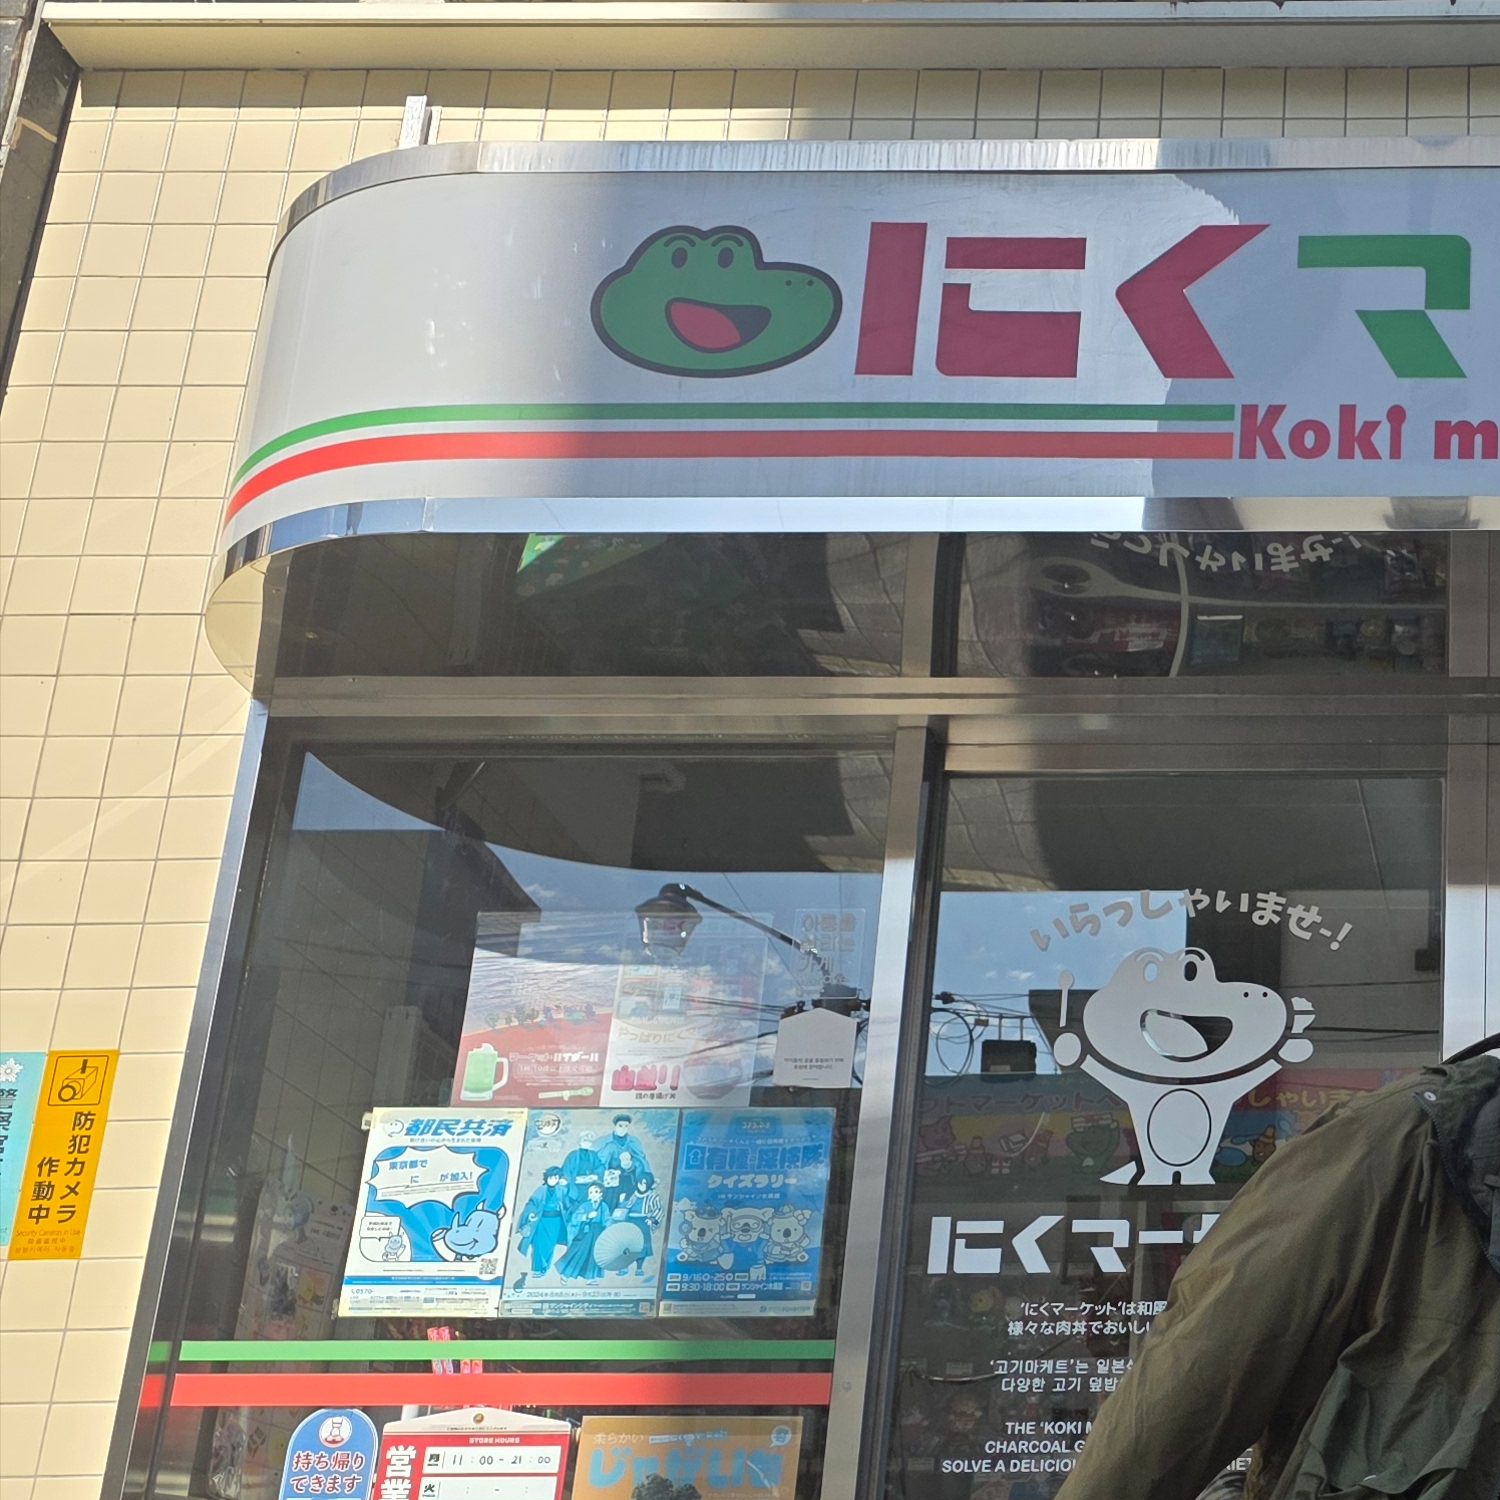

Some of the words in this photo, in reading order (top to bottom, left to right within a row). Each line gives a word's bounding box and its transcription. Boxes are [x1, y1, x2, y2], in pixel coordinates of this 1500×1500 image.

[1237, 403, 1405, 462] Koki
[404, 1118, 516, 1138] 都民共済
[56, 1111, 97, 1224] 防犯カメラ
[27, 1157, 60, 1225] 作動中
[707, 1173, 799, 1190] クイズラリー
[1001, 1377, 1046, 1392] 다양한
[1052, 1377, 1082, 1392] 고기
[1088, 1377, 1122, 1392] 덮밥
[1005, 1421, 1036, 1435] THE
[984, 1440, 1071, 1455] CHARCOAL
[292, 1450, 365, 1472] 持ち帰り
[941, 1459, 992, 1474] SOLVE
[994, 1459, 1006, 1473] A
[289, 1474, 363, 1495] できます
